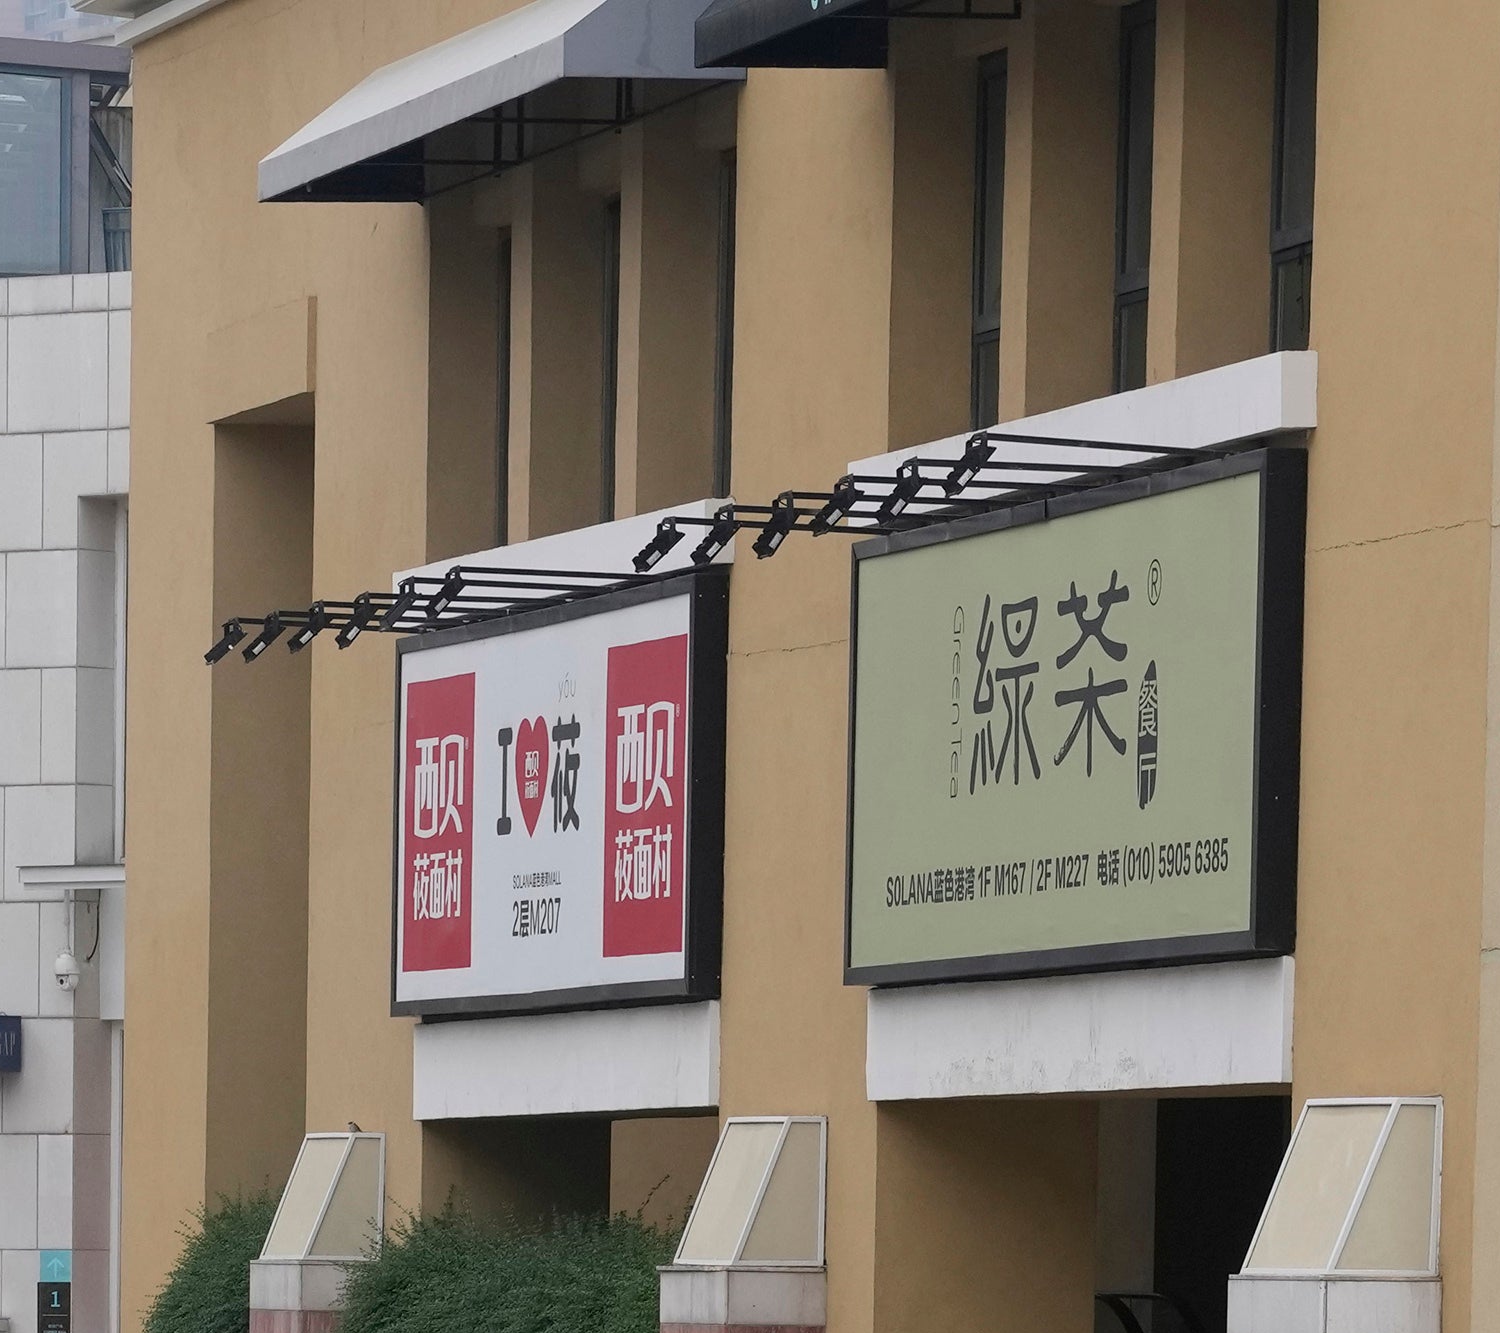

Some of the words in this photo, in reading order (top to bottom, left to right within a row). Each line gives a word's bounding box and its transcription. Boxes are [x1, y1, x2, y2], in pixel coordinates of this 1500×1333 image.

[551, 713, 581, 833] 莜
[1137, 678, 1159, 808] 餐厅
[412, 849, 463, 921] 莜面村
[614, 824, 673, 902] 莜面村
[977, 868, 992, 899] 1F
[994, 861, 1027, 898] M167
[1036, 858, 1052, 892] 2F
[1055, 853, 1090, 890] M227
[1097, 848, 1120, 887] 电话
[1122, 842, 1156, 887] (010)
[1158, 841, 1192, 880] 5905
[1194, 837, 1229, 874] 6385
[512, 897, 561, 938] 2层M207
[50, 1290, 61, 1308] 1
